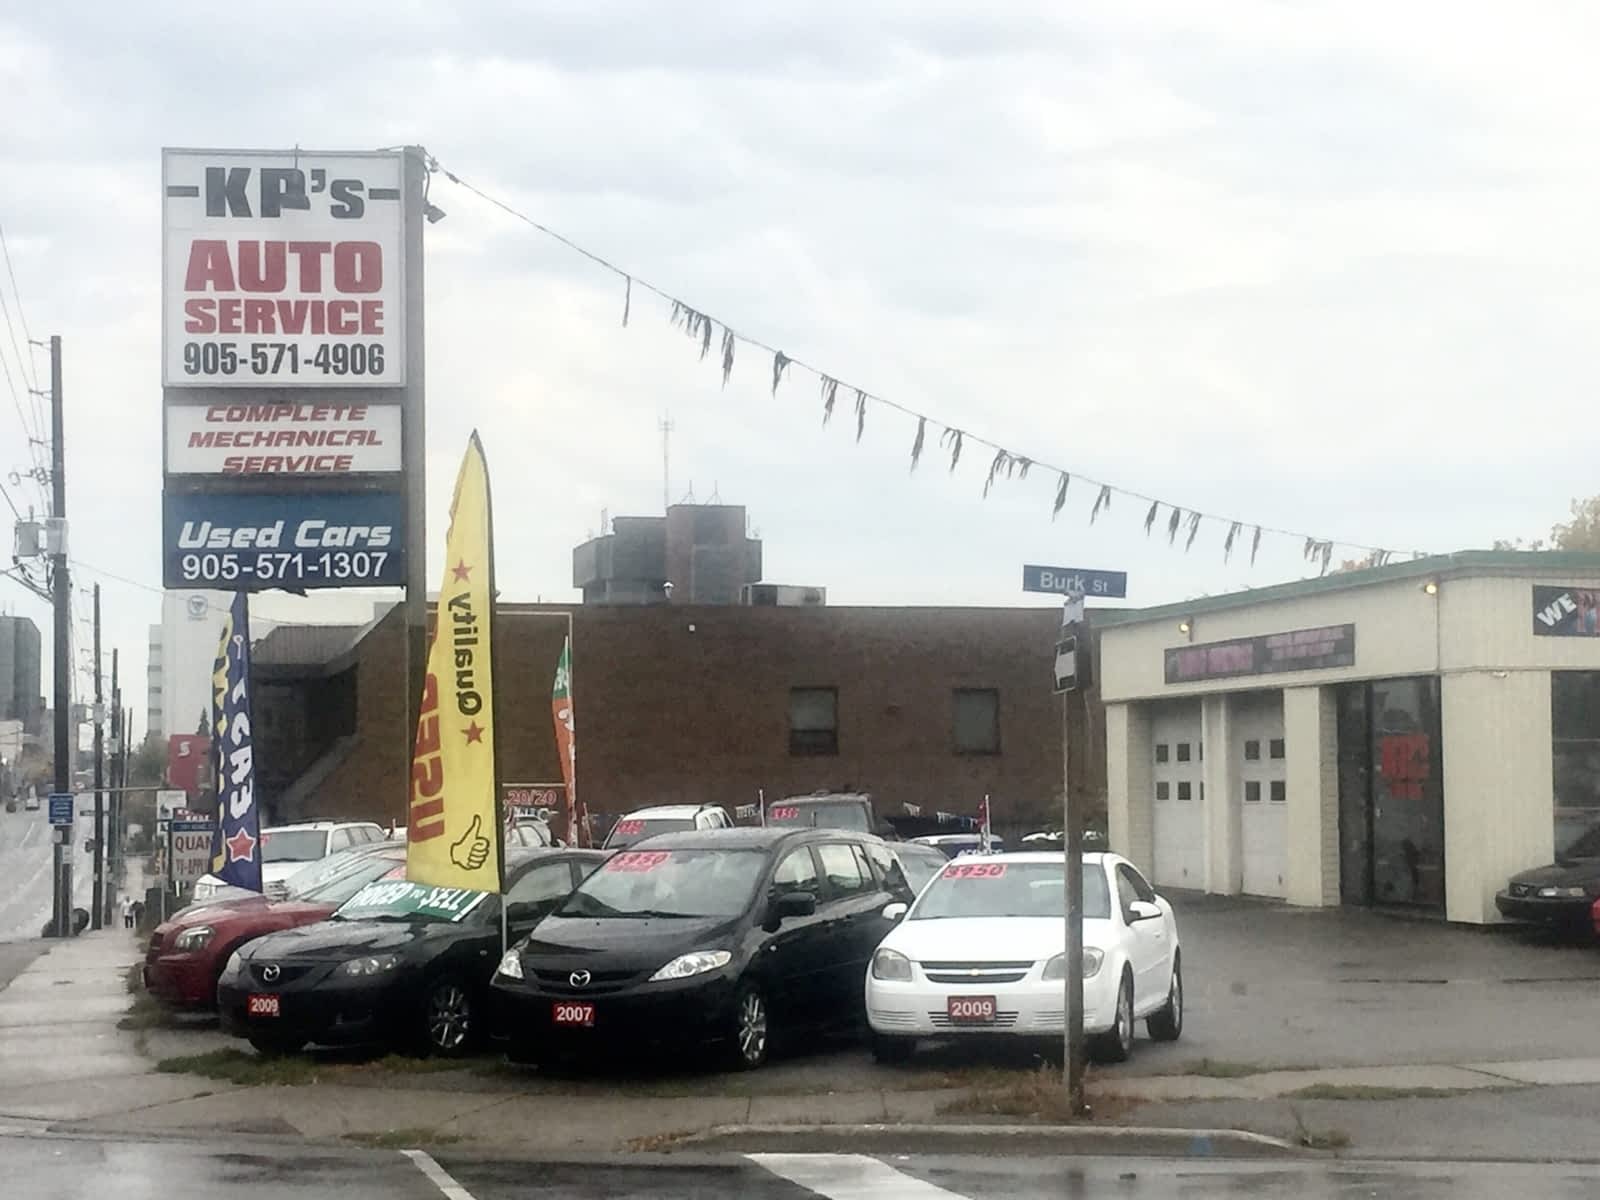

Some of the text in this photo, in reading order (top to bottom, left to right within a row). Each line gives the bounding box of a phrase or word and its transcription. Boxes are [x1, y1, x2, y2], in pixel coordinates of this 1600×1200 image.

[184, 240, 383, 293] AUTO
[184, 298, 384, 335] SERVICE
[184, 342, 385, 375] 905-571-4906
[205, 404, 368, 423] COMPLETE
[188, 430, 383, 448] MECHANICAL
[221, 455, 354, 473] SERVICE
[178, 520, 392, 549] Used Cars
[182, 553, 388, 580] 905-571-1307
[1040, 571, 1109, 593] Burk St
[1537, 593, 1577, 626] WE
[557, 1006, 592, 1021] 2007
[952, 1001, 992, 1016] 2009
